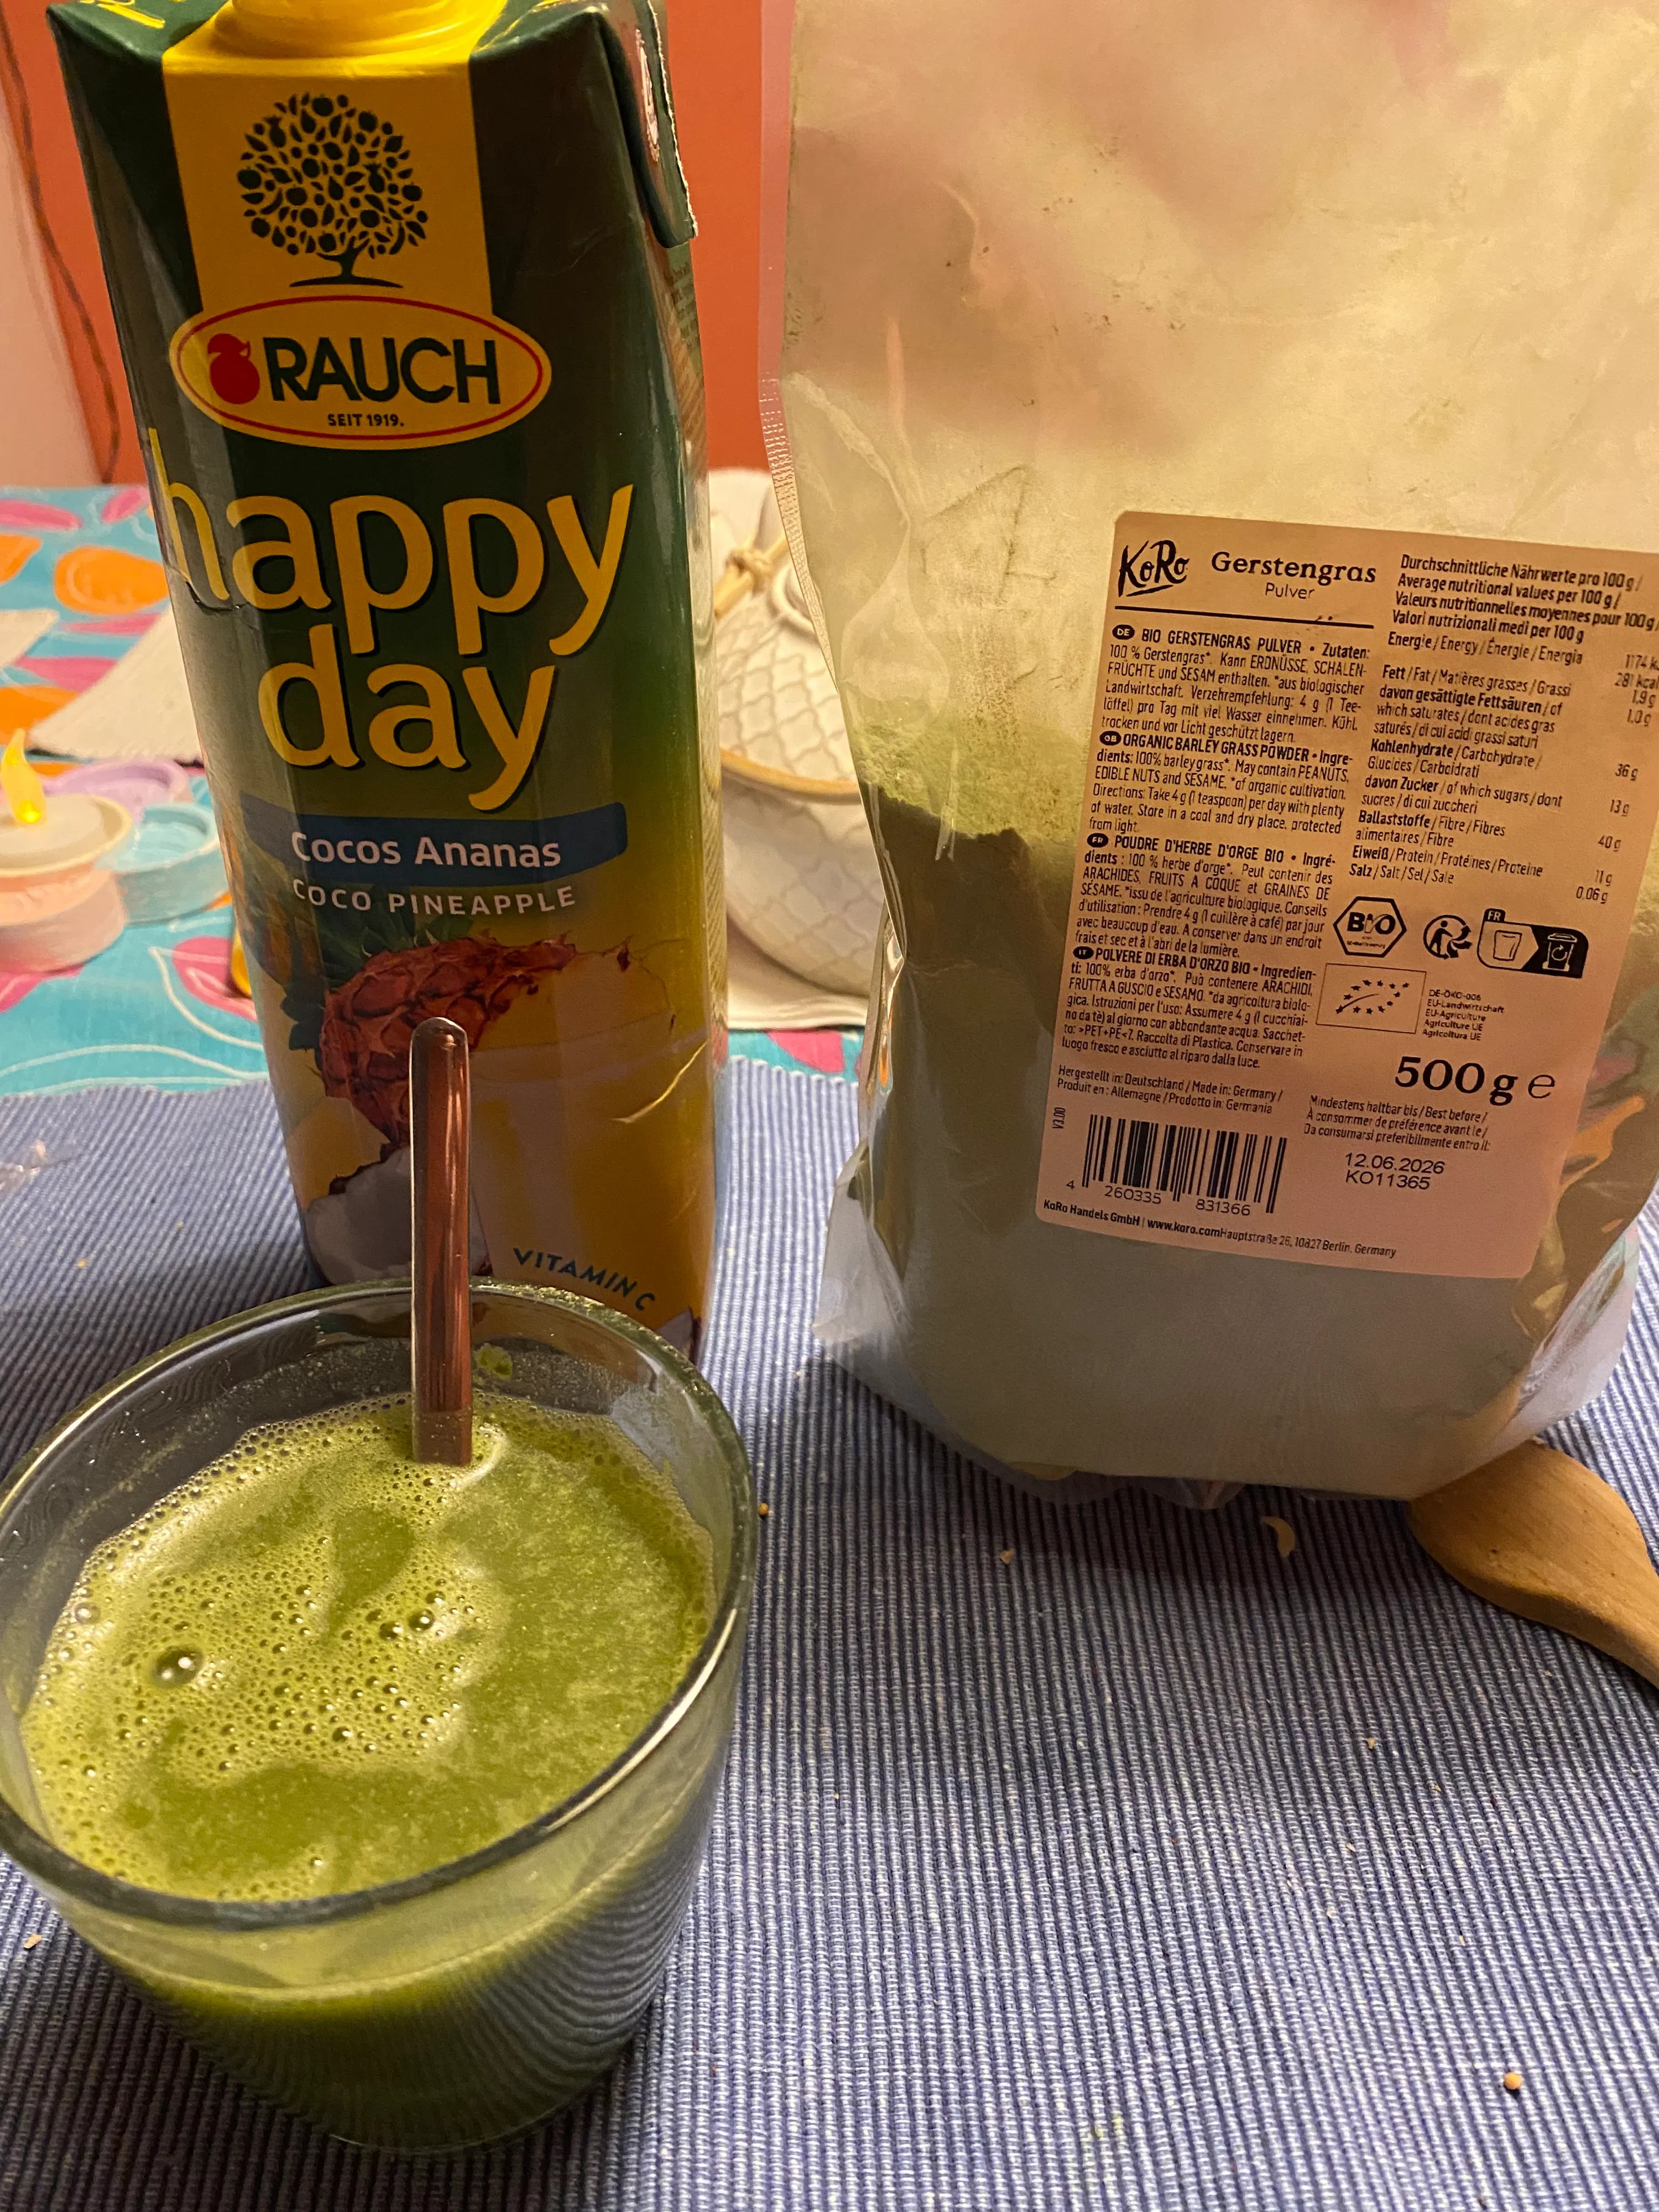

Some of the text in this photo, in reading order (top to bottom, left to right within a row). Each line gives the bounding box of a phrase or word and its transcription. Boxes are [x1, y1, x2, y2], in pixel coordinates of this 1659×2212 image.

[263, 336, 502, 405] RAUCH
[327, 413, 363, 427] SEIT
[148, 428, 634, 657] happy
[1117, 539, 1191, 598] KoRo
[1211, 551, 1376, 587] Gerstengras
[1400, 554, 1635, 592] Durchschnittliche Nährwerte pro 100 g
[1265, 582, 1315, 599] Pulver
[1397, 572, 1613, 609] Average nutritional values per 100 g
[1395, 590, 1655, 631] Valeurs nutritionnelles moyennes pour 100 g
[1392, 609, 1585, 644] Valori nutrizionali medi per 100 g
[1141, 628, 1161, 644] BIO
[1167, 630, 1251, 651] GERSTENGRAS
[1256, 637, 1302, 654] PULVER
[1110, 644, 1128, 659] 100
[1131, 645, 1140, 660] %
[1219, 652, 1246, 667] Kann
[1313, 660, 1367, 677] SCHALEN-
[1107, 661, 1156, 678] FRÜCHTE
[1158, 666, 1178, 680] und
[1180, 666, 1216, 683] SESAM
[1218, 671, 1270, 687] enthalten.
[1300, 676, 1365, 696] biologischer
[1136, 702, 1155, 715] pro
[1160, 700, 1177, 718] Tag
[1181, 703, 1199, 717] mit
[1203, 704, 1221, 719] viel
[1226, 706, 1262, 723] Wasser
[1191, 686, 1295, 709] Verzehrempfehlung:
[1299, 695, 1307, 708] 4
[1311, 699, 1319, 712] g
[1340, 698, 1361, 713] Tee-
[258, 623, 556, 811] day
[1101, 714, 1139, 729] trocken
[1141, 718, 1161, 732] und
[1163, 722, 1178, 733] vor
[1181, 720, 1207, 735] Licht
[1208, 724, 1259, 740] geschützt
[1123, 733, 1174, 750] ORGANIC
[1175, 737, 1220, 754] BARLEY
[1220, 741, 1259, 757] GRASS
[1259, 744, 1310, 762] POWDER
[1319, 749, 1353, 766] Ingre-
[1163, 753, 1196, 771] barley
[1234, 759, 1256, 777] May
[1257, 763, 1296, 778] contain
[1615, 764, 1639, 782] 36 g
[1094, 765, 1130, 781] EDIBLE
[1131, 768, 1161, 784] NUTS
[1162, 771, 1182, 785] and
[1248, 781, 1287, 795] organic
[1621, 804, 1630, 817] g
[291, 831, 561, 868] Cocos Ananas
[1114, 834, 1160, 852] POUDRE
[1164, 838, 1213, 857] D'HERBE
[1217, 843, 1260, 861] D'ORGE
[1264, 848, 1285, 863] BIO
[1302, 852, 1336, 868] Ingré-
[1597, 834, 1622, 852] 40 g
[1084, 849, 1118, 865] dients
[1129, 853, 1145, 867] 100
[1149, 854, 1159, 869] %
[1162, 855, 1191, 872] herbe
[1241, 863, 1265, 878] Peut
[1269, 868, 1312, 882] contenir
[1315, 870, 1333, 885] des
[1605, 874, 1613, 887] g
[293, 878, 576, 916] COCO PINEAPPLE
[1488, 910, 1501, 921] FR
[1095, 947, 1143, 964] POLVERE
[1144, 951, 1156, 966] DI
[1157, 953, 1187, 968] ERBA
[1189, 956, 1229, 973] D'ORZO
[1231, 961, 1251, 975] BIO
[1260, 963, 1317, 981] Ingredien-
[1425, 1008, 1486, 1022] EU-Agriculture
[1427, 998, 1505, 1014] EU-Landwirtschaft
[1422, 1029, 1481, 1041] Agricoltura UE
[1423, 1019, 1484, 1032] Agriculture UE
[1395, 1056, 1519, 1107] 500 g
[1345, 1152, 1446, 1175] 12.06.2026
[1066, 1180, 1075, 1190] 4
[1345, 1169, 1431, 1191] KO11365
[1104, 1185, 1161, 1204] 260335
[1195, 1198, 1251, 1217] 831366
[1044, 1199, 1068, 1213] KoRo
[1070, 1204, 1109, 1221] Handels
[1110, 1212, 1141, 1226] GmbH
[1295, 1237, 1322, 1249] 10827
[1354, 1243, 1397, 1258] Germany
[513, 1248, 656, 1311] VITAMIN C
